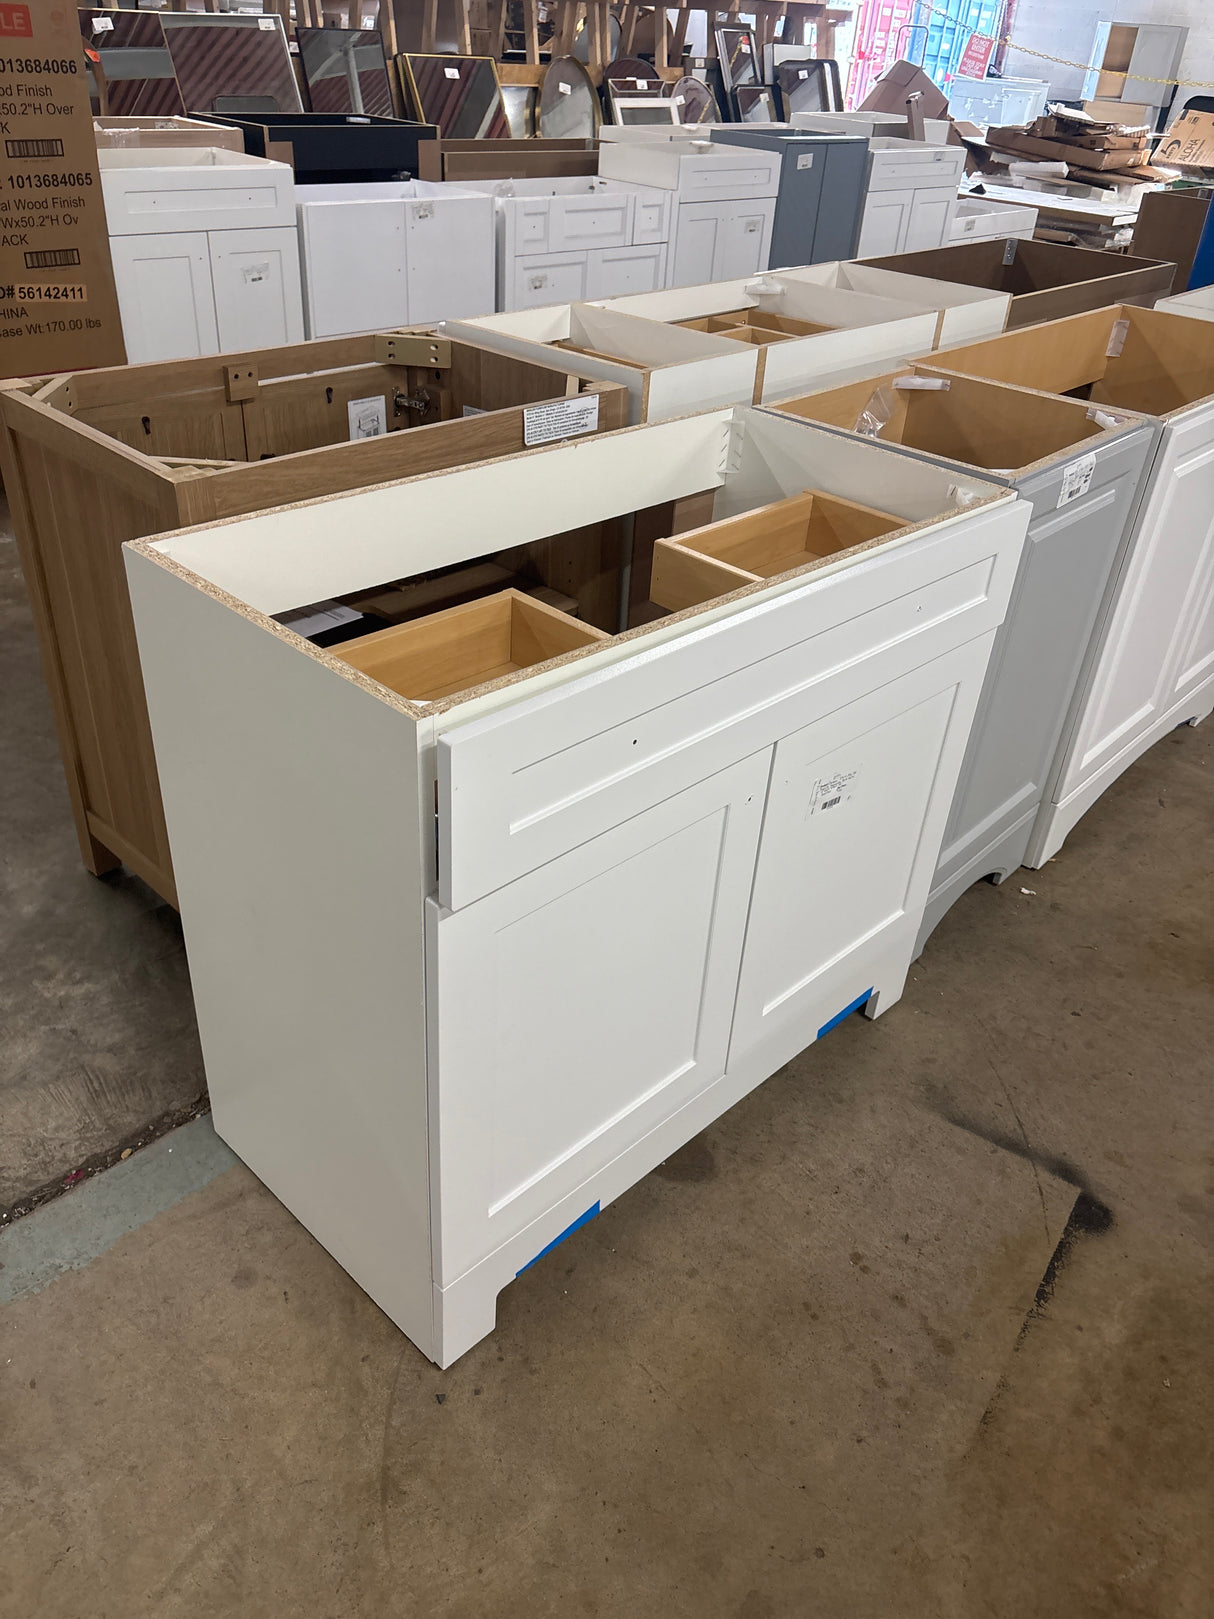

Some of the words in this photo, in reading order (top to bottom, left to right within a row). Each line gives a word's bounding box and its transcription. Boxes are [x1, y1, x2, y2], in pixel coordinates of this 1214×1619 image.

[16, 84, 53, 97] Finish
[0, 102, 43, 116] 50.2"H
[46, 102, 74, 116] Over
[1178, 139, 1200, 161] ALOHA
[7, 172, 93, 189] 1013684065
[13, 198, 48, 211] Wood
[51, 196, 86, 209] Finish
[62, 213, 79, 226] Ov
[1, 234, 29, 247] ACK
[18, 286, 84, 300] 56142411
[85, 317, 102, 329] lbs
